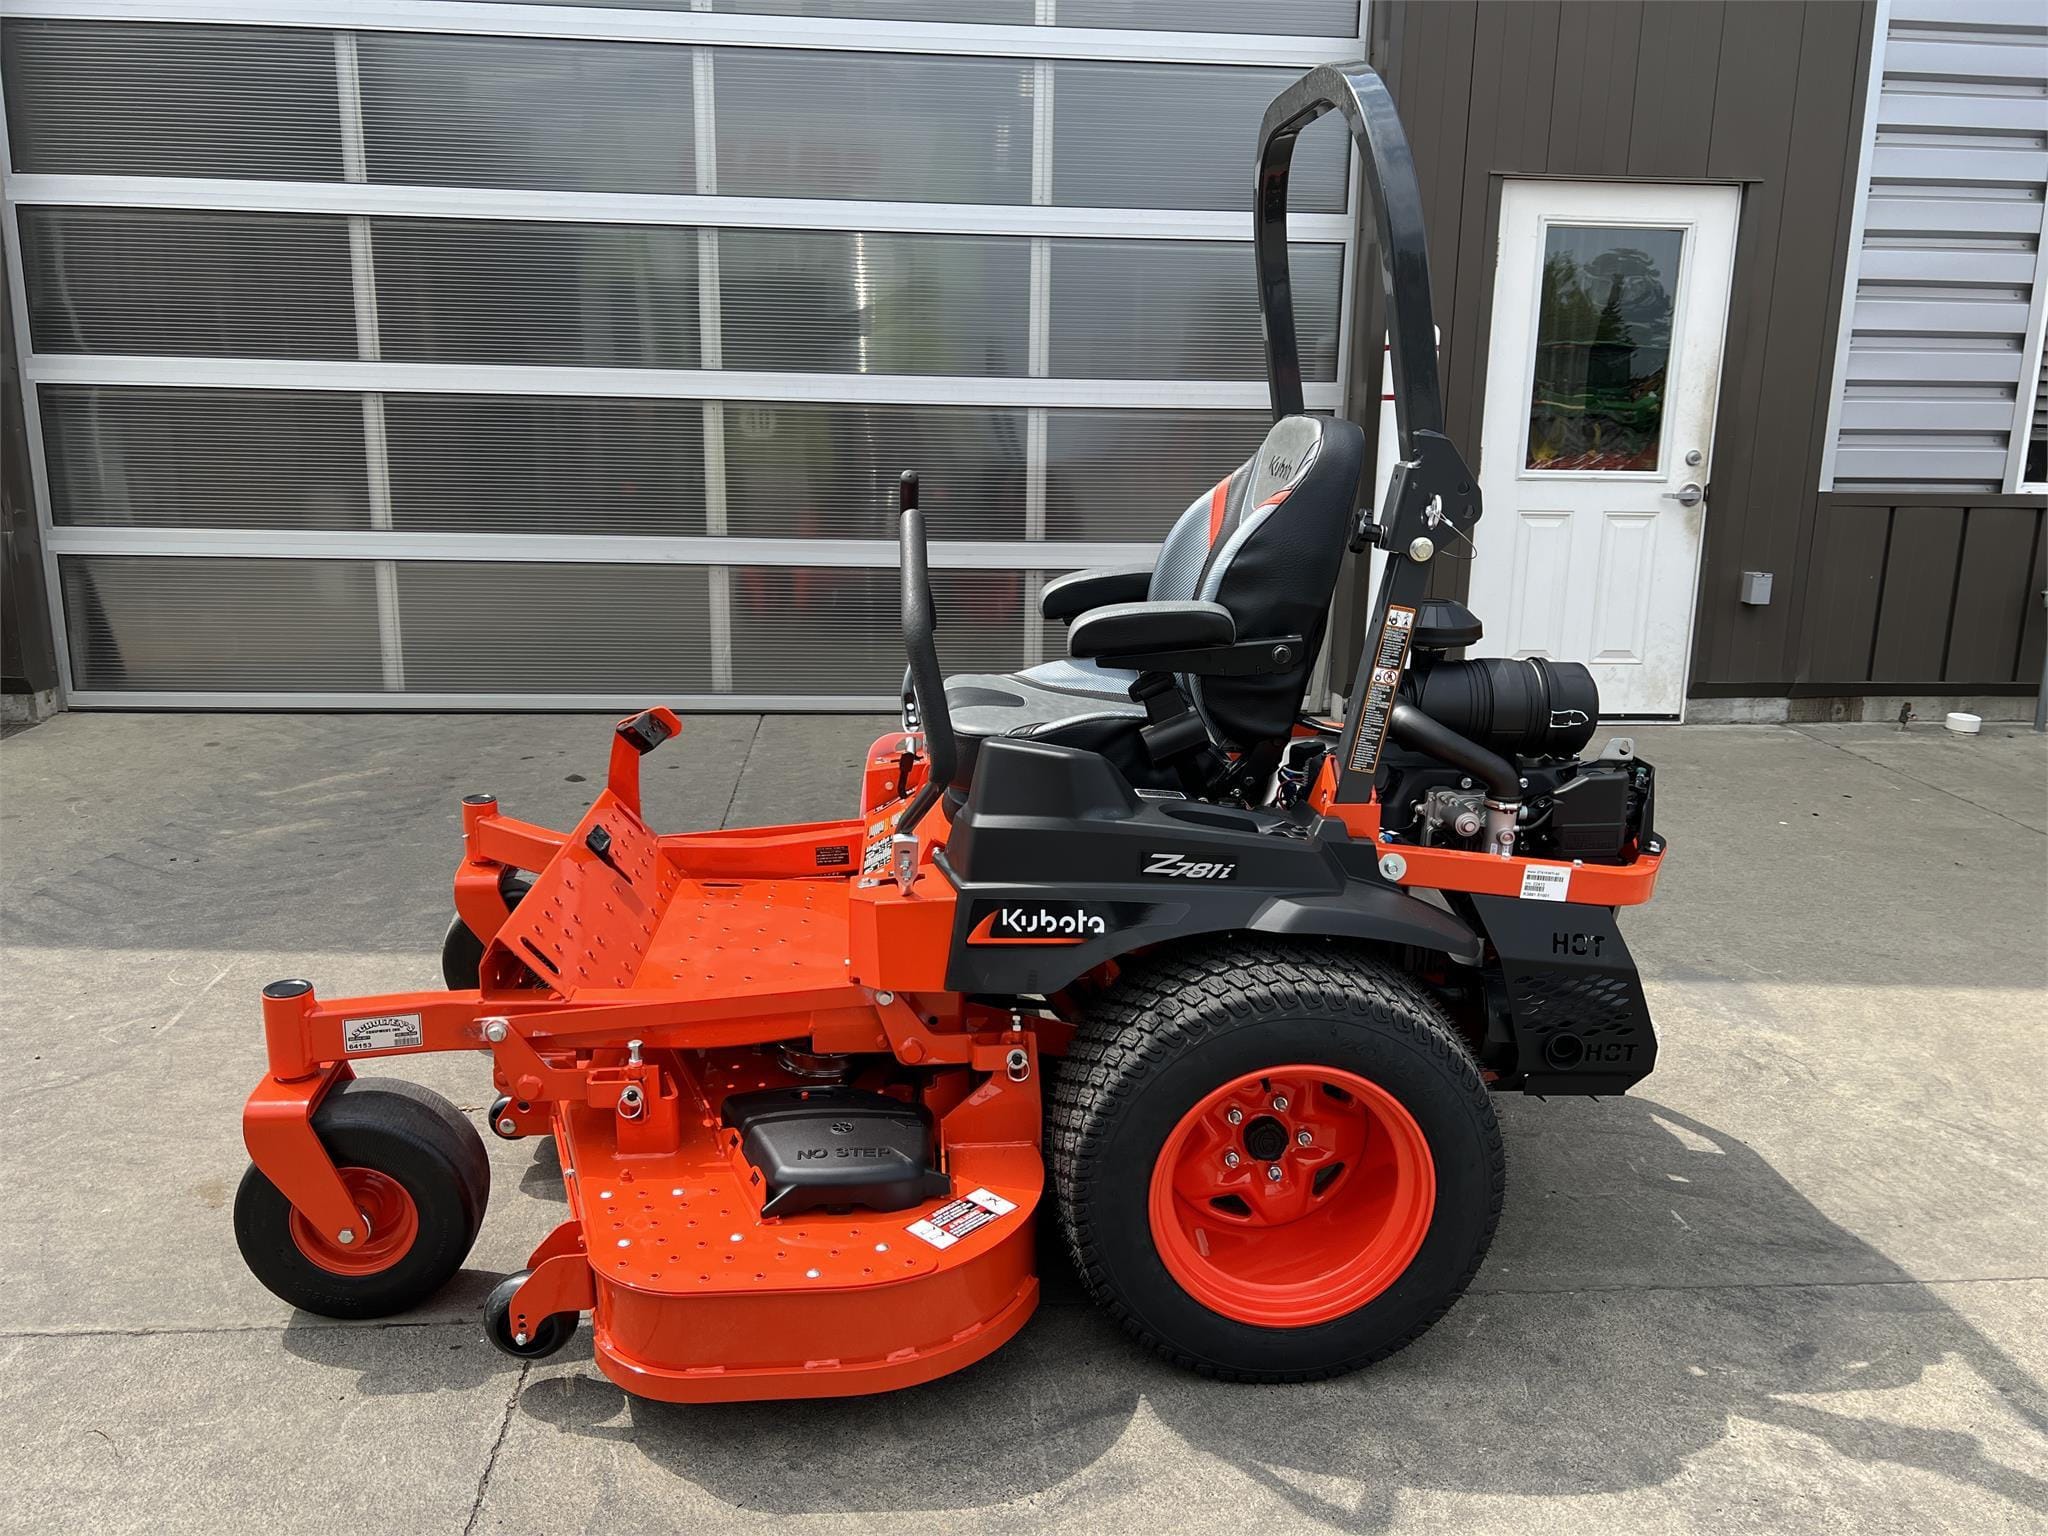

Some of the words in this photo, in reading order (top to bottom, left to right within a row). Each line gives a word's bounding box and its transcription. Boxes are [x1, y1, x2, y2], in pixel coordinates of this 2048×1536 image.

[1142, 853, 1236, 880] Z781i
[1001, 908, 1105, 934] Kubota
[1552, 932, 1605, 957] HOT
[1584, 1043, 1639, 1062] HOT
[796, 1149, 828, 1161] NO
[835, 1147, 892, 1158] STEP
